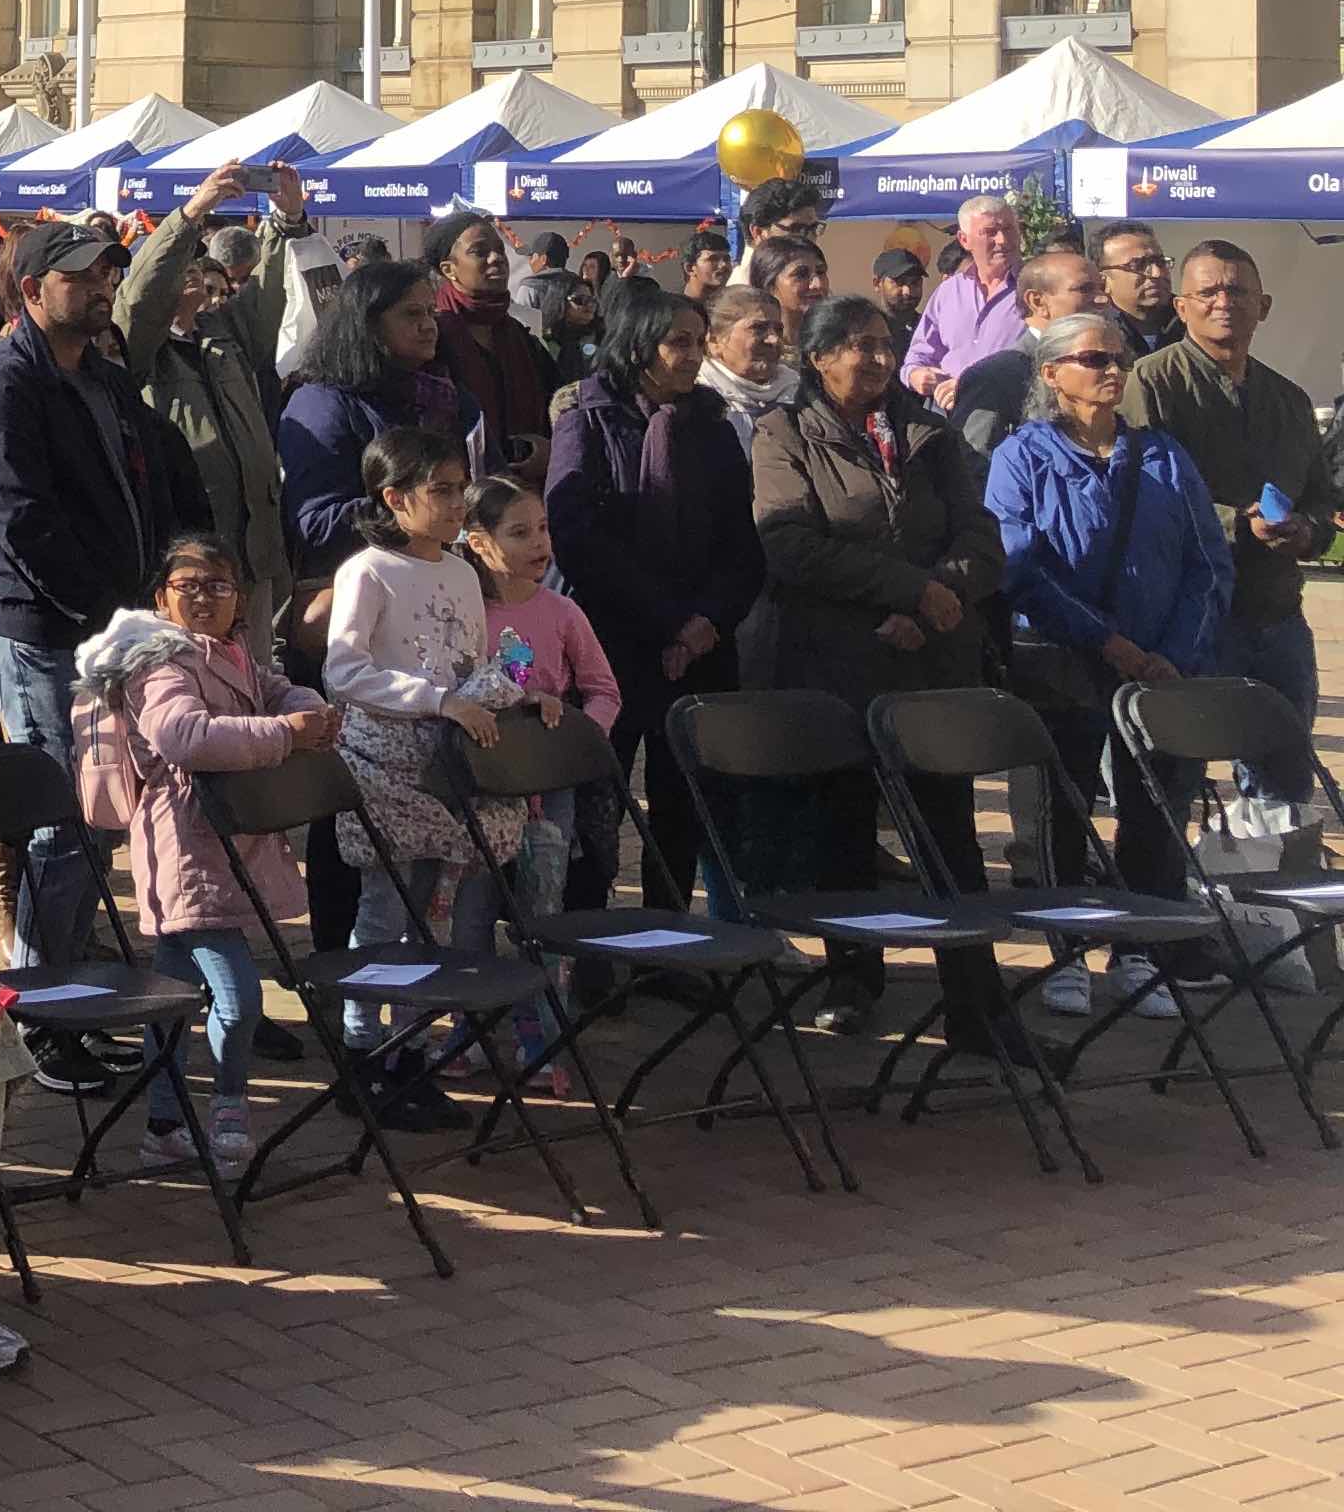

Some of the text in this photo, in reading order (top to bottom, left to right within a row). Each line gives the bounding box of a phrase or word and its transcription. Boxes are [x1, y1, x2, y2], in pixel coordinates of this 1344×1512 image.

[1152, 164, 1198, 181] Diwali
[306, 178, 328, 190] Diwali
[520, 174, 548, 187] Diwali
[616, 179, 654, 195] WMCA
[877, 172, 1011, 195] Birmingham Airport
[1308, 172, 1340, 193] Ola
[314, 192, 336, 203] square
[364, 183, 428, 197] Incredible India
[530, 189, 559, 202] square
[1169, 185, 1216, 201] square
